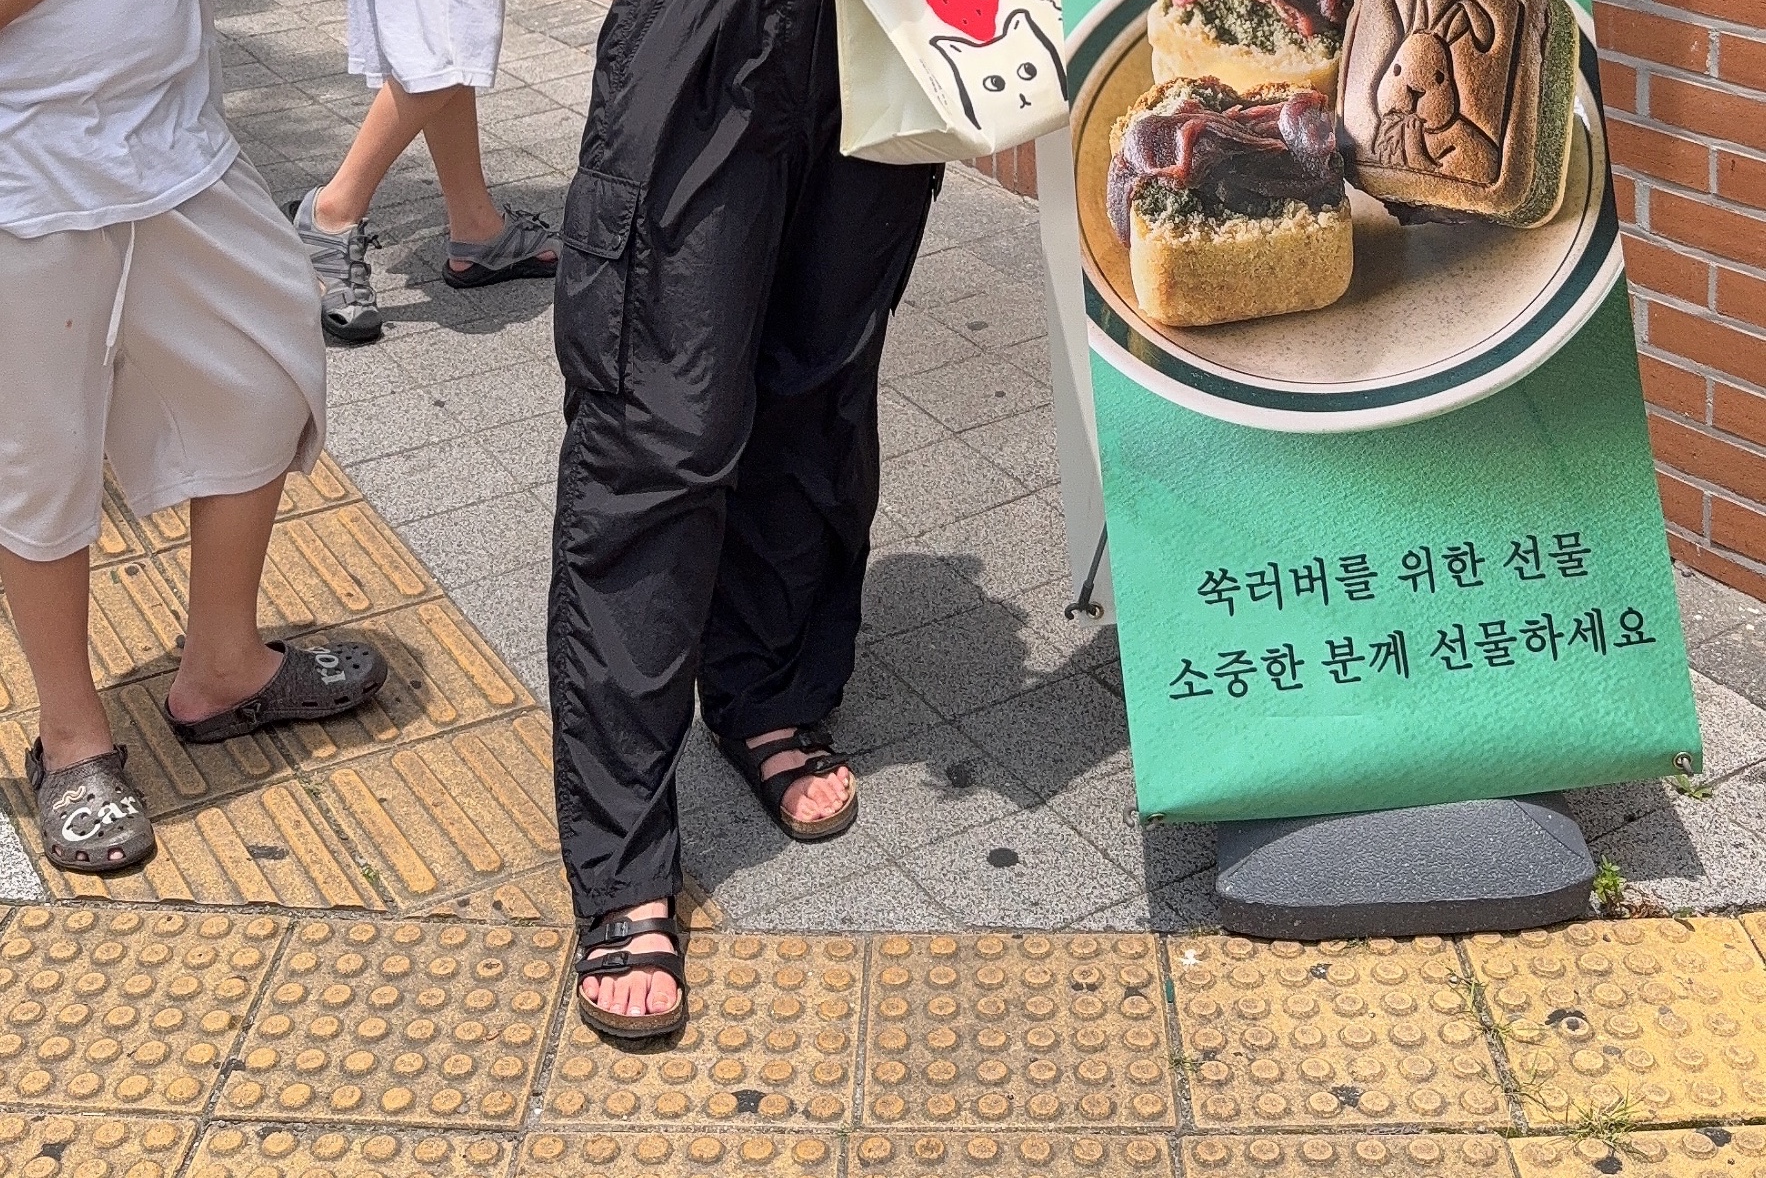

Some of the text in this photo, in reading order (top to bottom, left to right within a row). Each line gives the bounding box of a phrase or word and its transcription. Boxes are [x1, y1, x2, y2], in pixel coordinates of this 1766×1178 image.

[1197, 531, 1593, 617] 쑥러버를 위한 선물
[1168, 606, 1657, 701] 소중한 분께 선물하세요
[61, 794, 140, 843] Car
